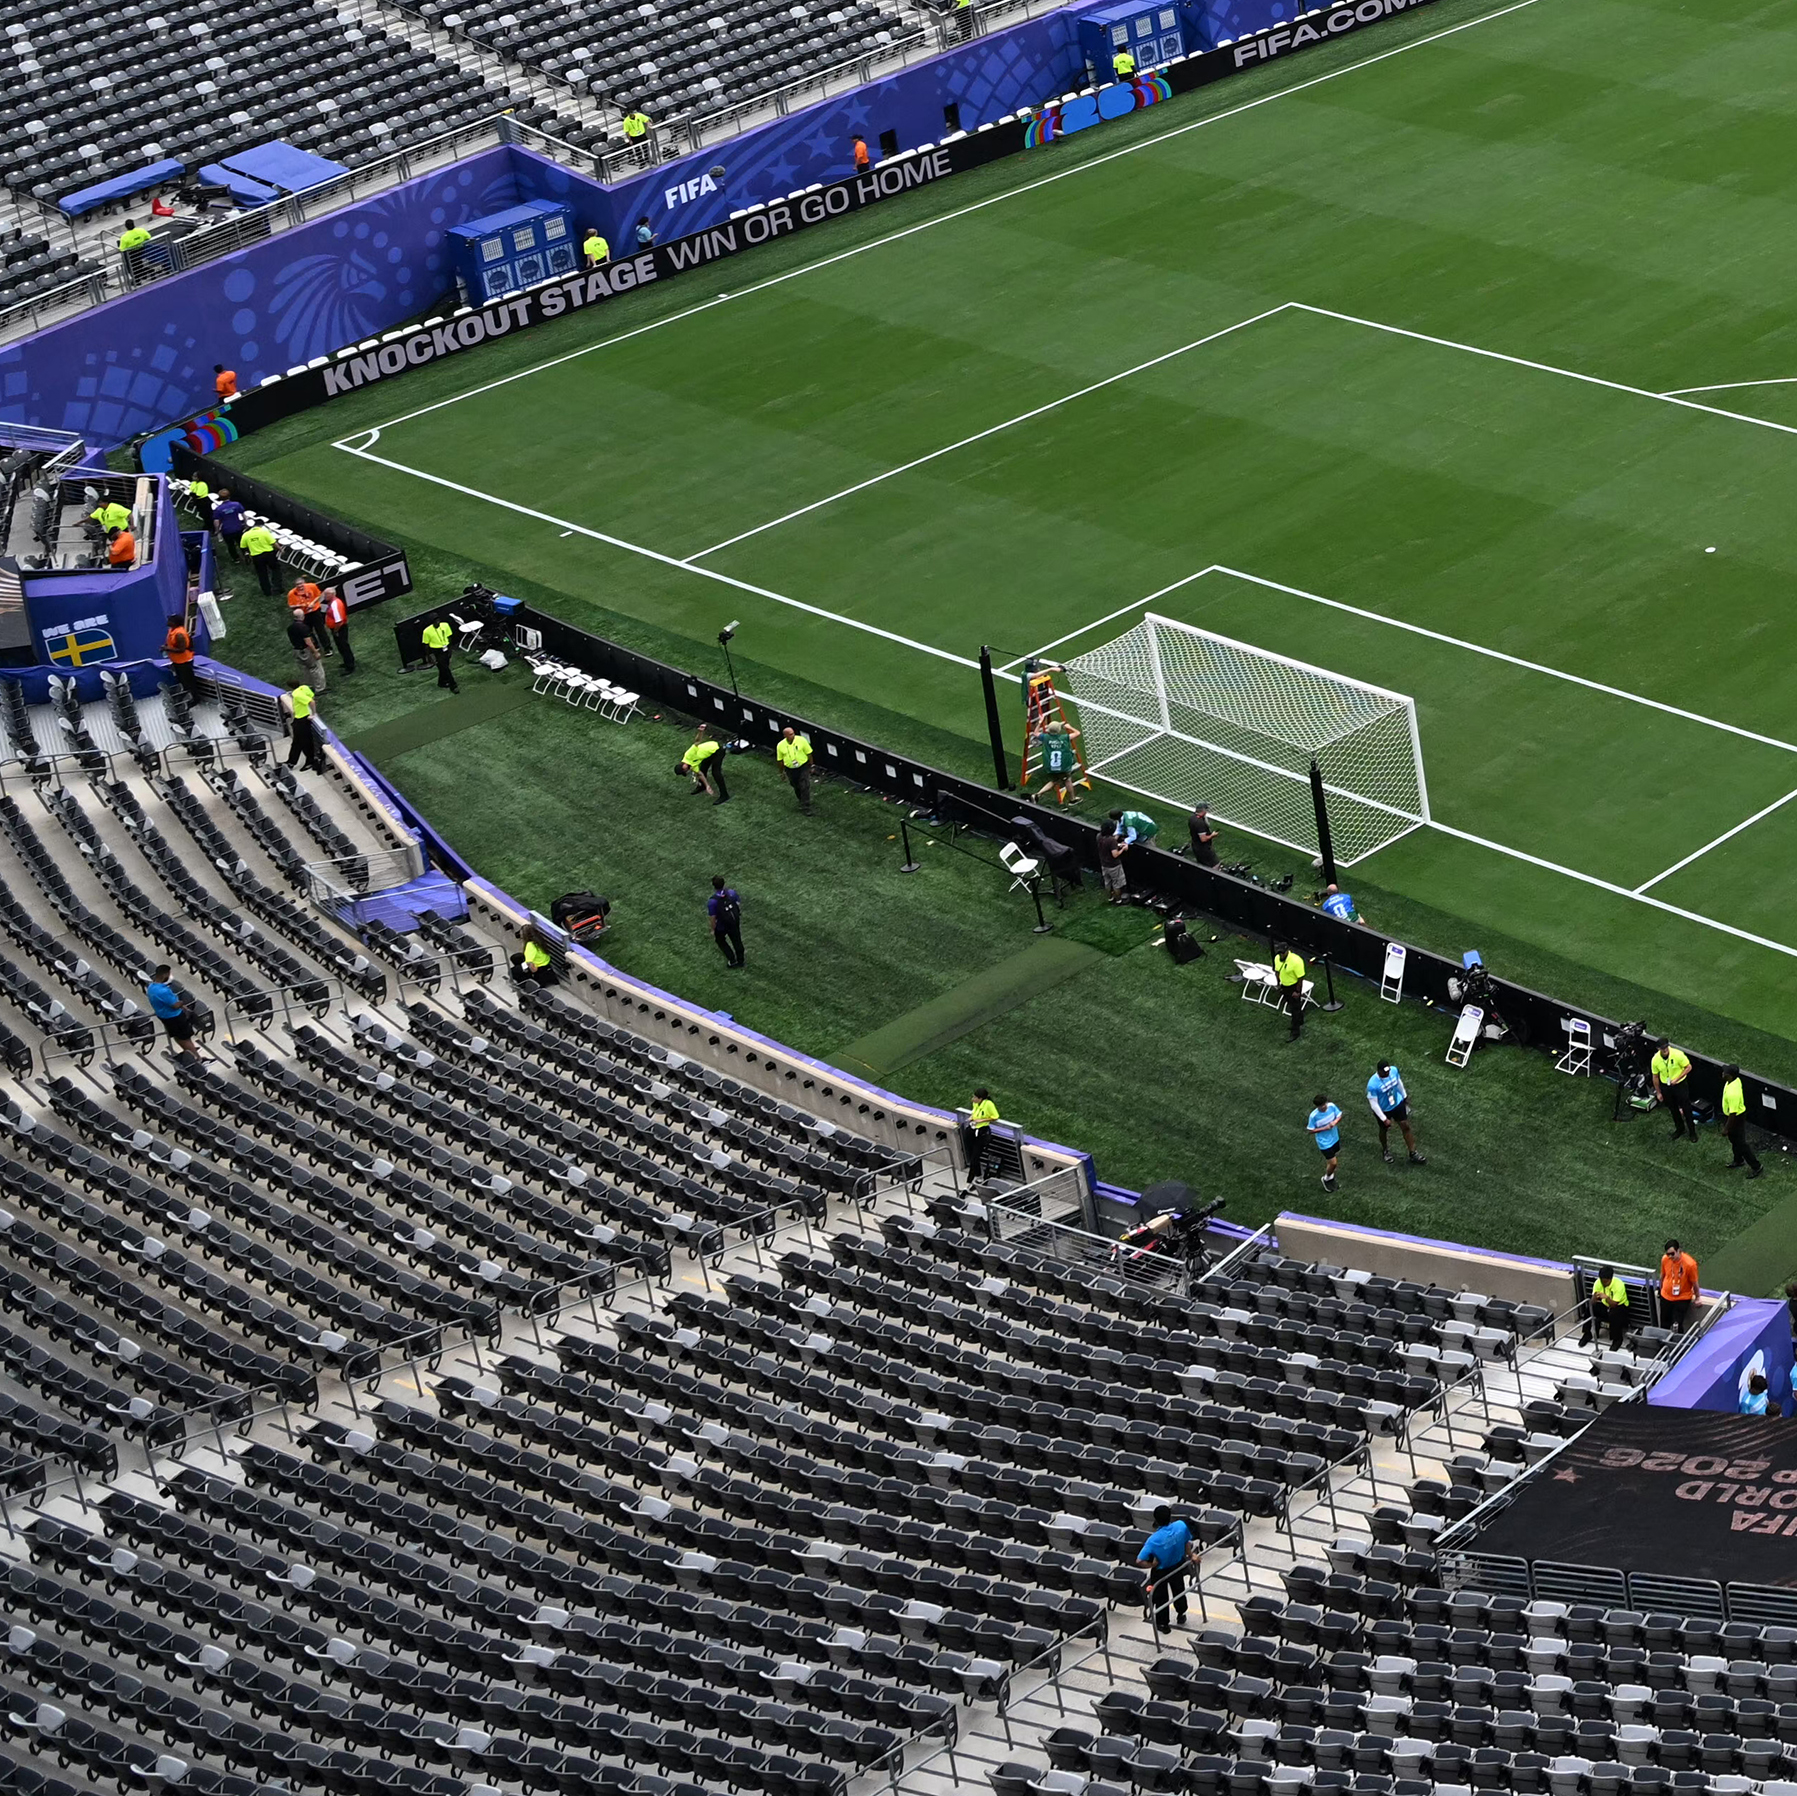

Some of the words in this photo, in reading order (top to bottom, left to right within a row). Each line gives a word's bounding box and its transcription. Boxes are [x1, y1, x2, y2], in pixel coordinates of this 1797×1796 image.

[665, 174, 718, 209] FIFA
[323, 299, 536, 396] KNOCKOUT
[540, 252, 658, 315] STAGE
[667, 226, 736, 270] WIN
[745, 207, 793, 243] OR
[801, 187, 849, 223] GO
[858, 149, 952, 203] HOME
[1599, 1447, 1771, 1480] 2026
